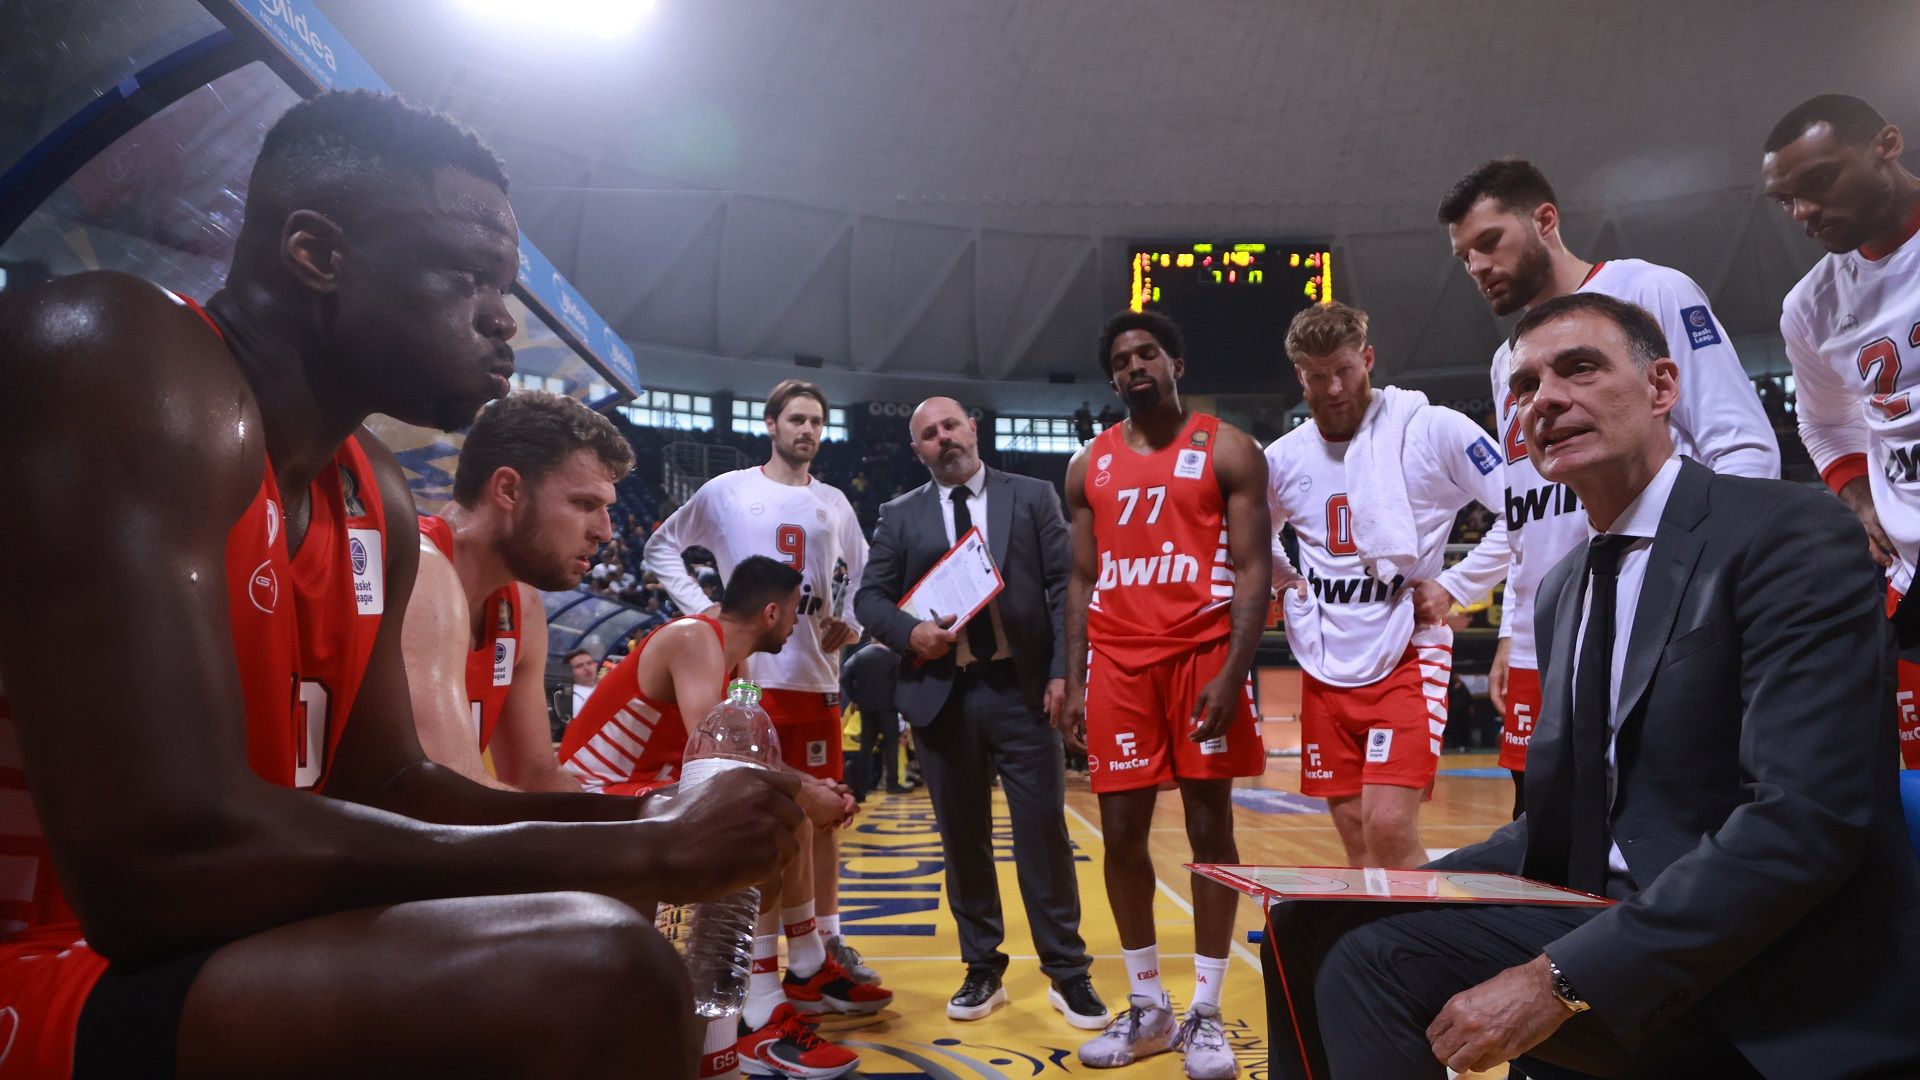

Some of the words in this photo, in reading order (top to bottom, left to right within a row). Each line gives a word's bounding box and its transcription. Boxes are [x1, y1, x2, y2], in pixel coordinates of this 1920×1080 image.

[1117, 486, 1166, 526] 77
[1325, 492, 1359, 557] 0
[776, 524, 806, 573] 9
[1099, 541, 1199, 591] bwin
[355, 580, 372, 591] asket
[356, 594, 373, 605] eague
[1109, 758, 1150, 772] FlexCar
[1305, 769, 1334, 779] lexCar
[1137, 969, 1158, 981] GSA
